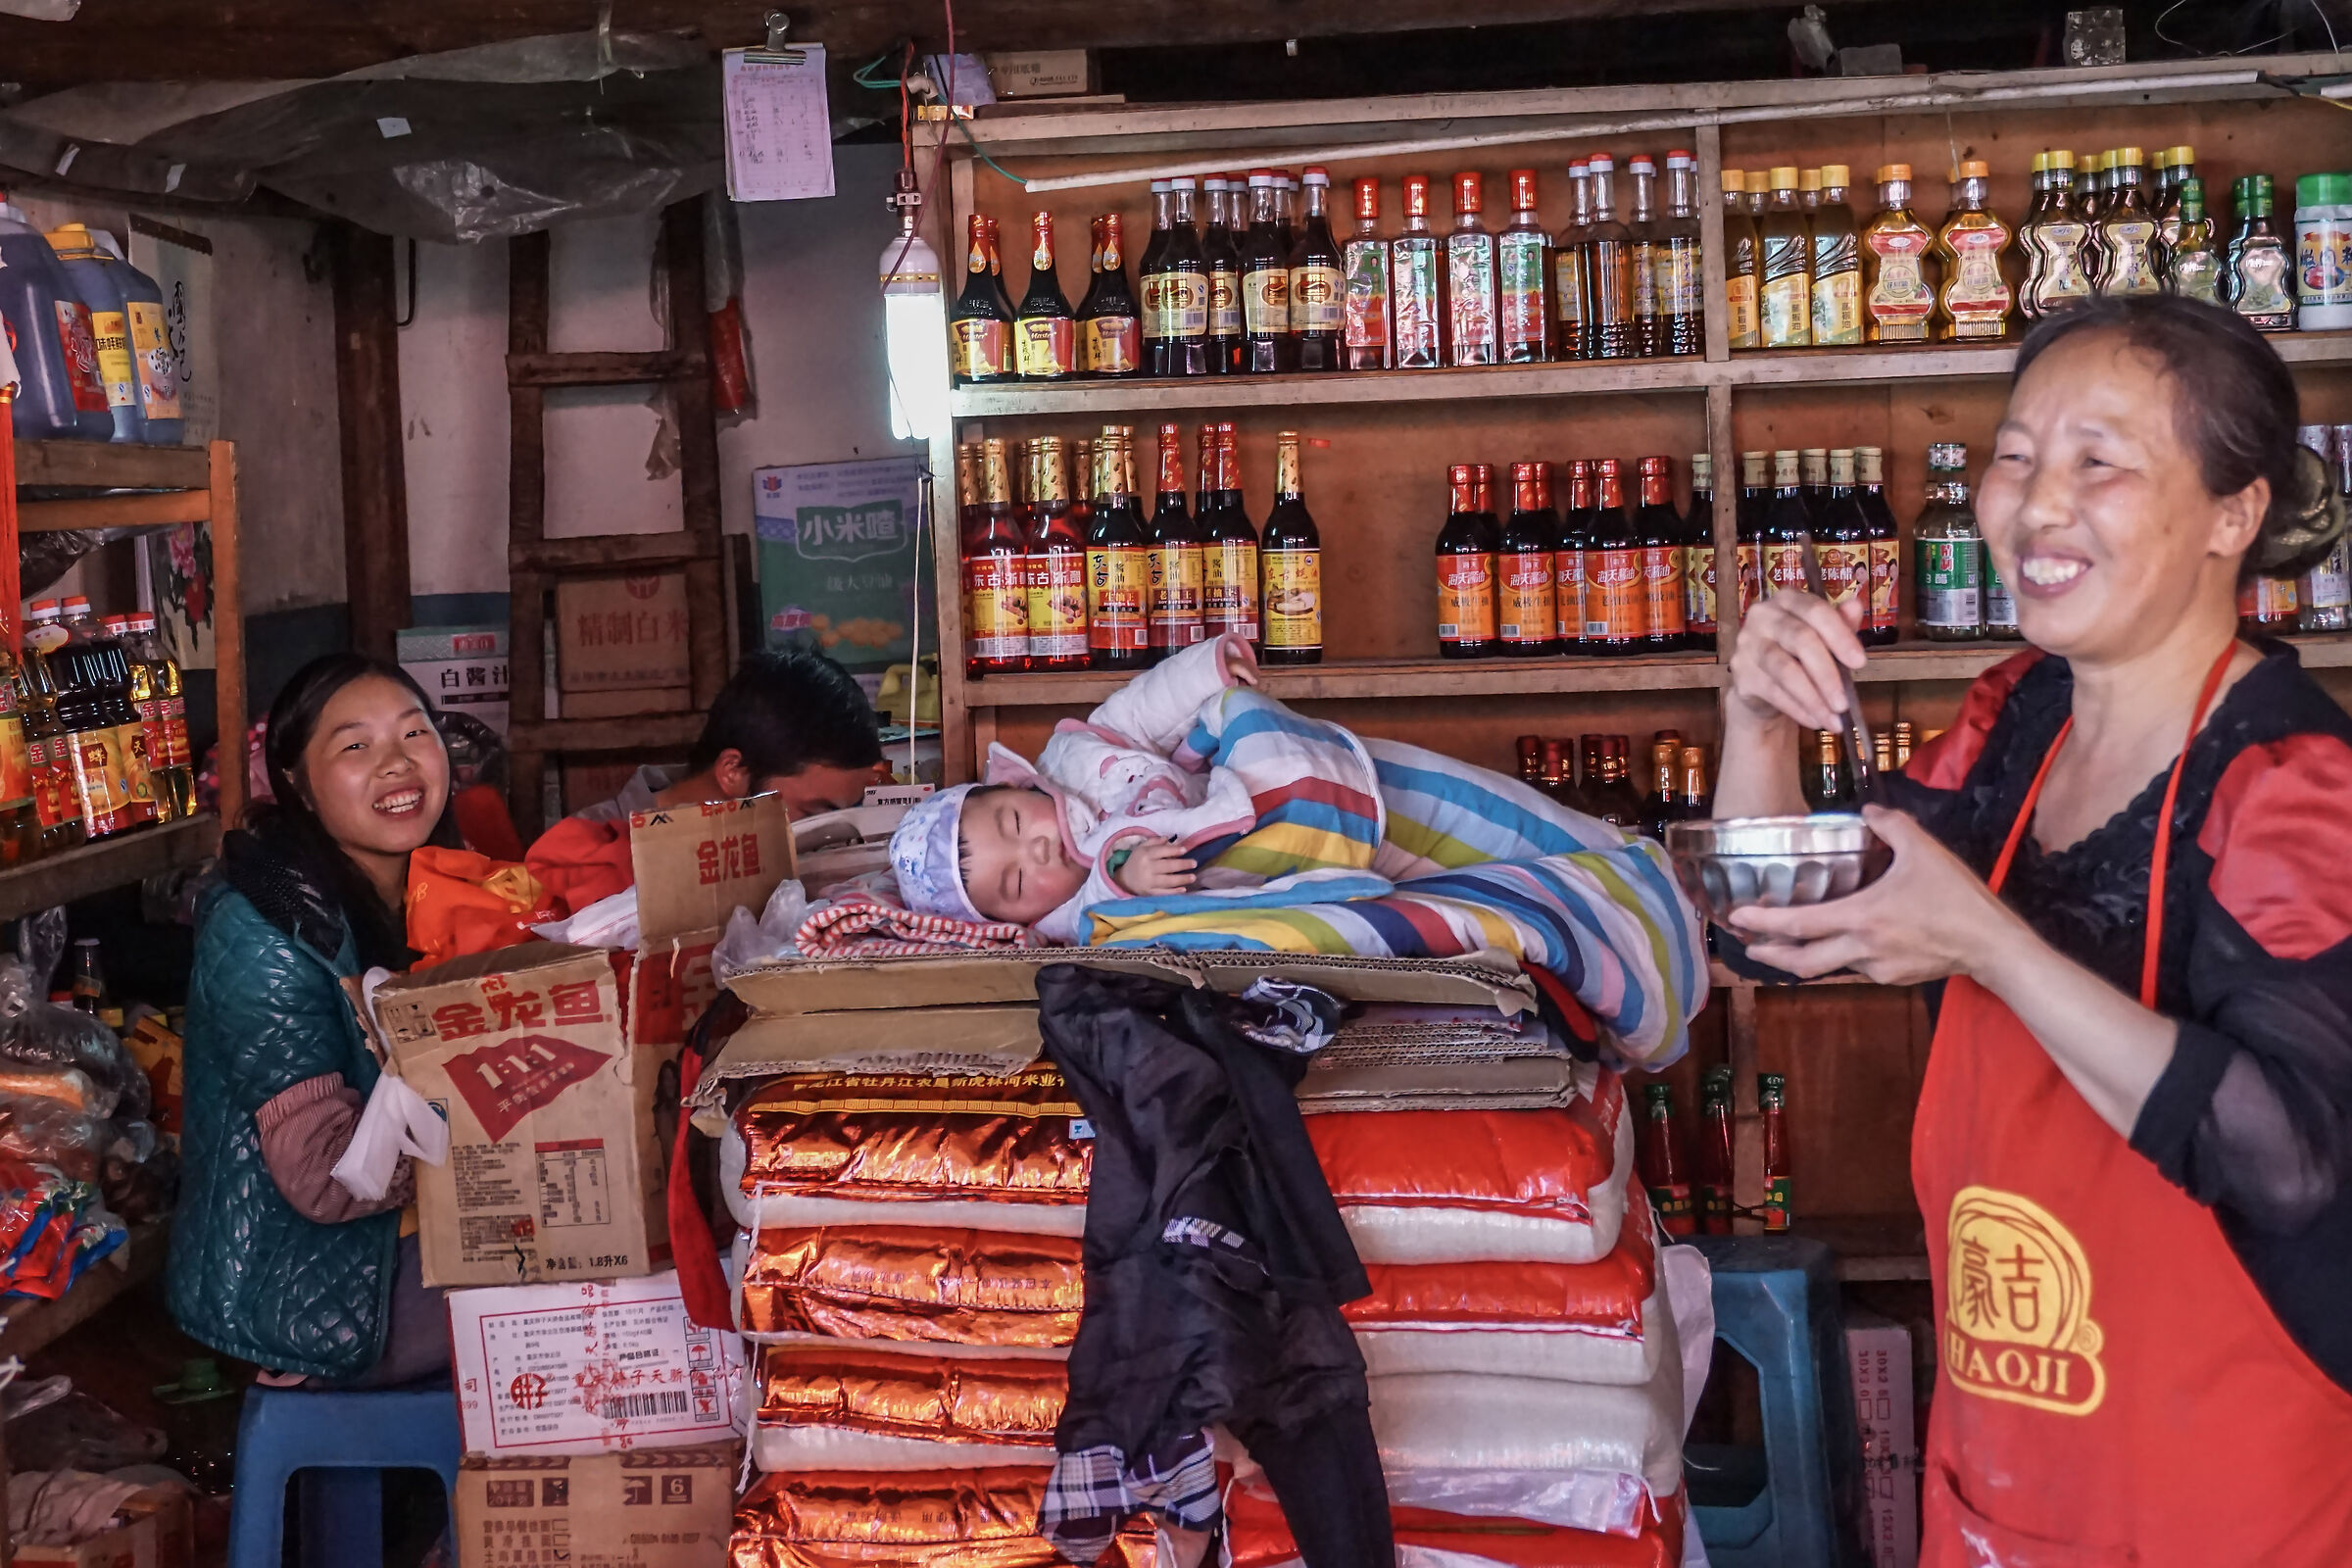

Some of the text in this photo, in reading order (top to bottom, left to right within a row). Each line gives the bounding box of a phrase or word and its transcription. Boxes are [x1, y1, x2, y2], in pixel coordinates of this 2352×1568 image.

[1447, 570, 1486, 586] 海天酱油
[1510, 570, 1547, 586] 海天酱油
[1597, 566, 1635, 583] 海天酱油
[697, 833, 761, 885] 金龙鱼
[431, 980, 605, 1042] 金龙鱼
[476, 1043, 557, 1090] 1:1:1
[1960, 1236, 2044, 1334] 豪吉
[1949, 1331, 2071, 1396] HAOJI
[670, 1479, 684, 1494] 6
